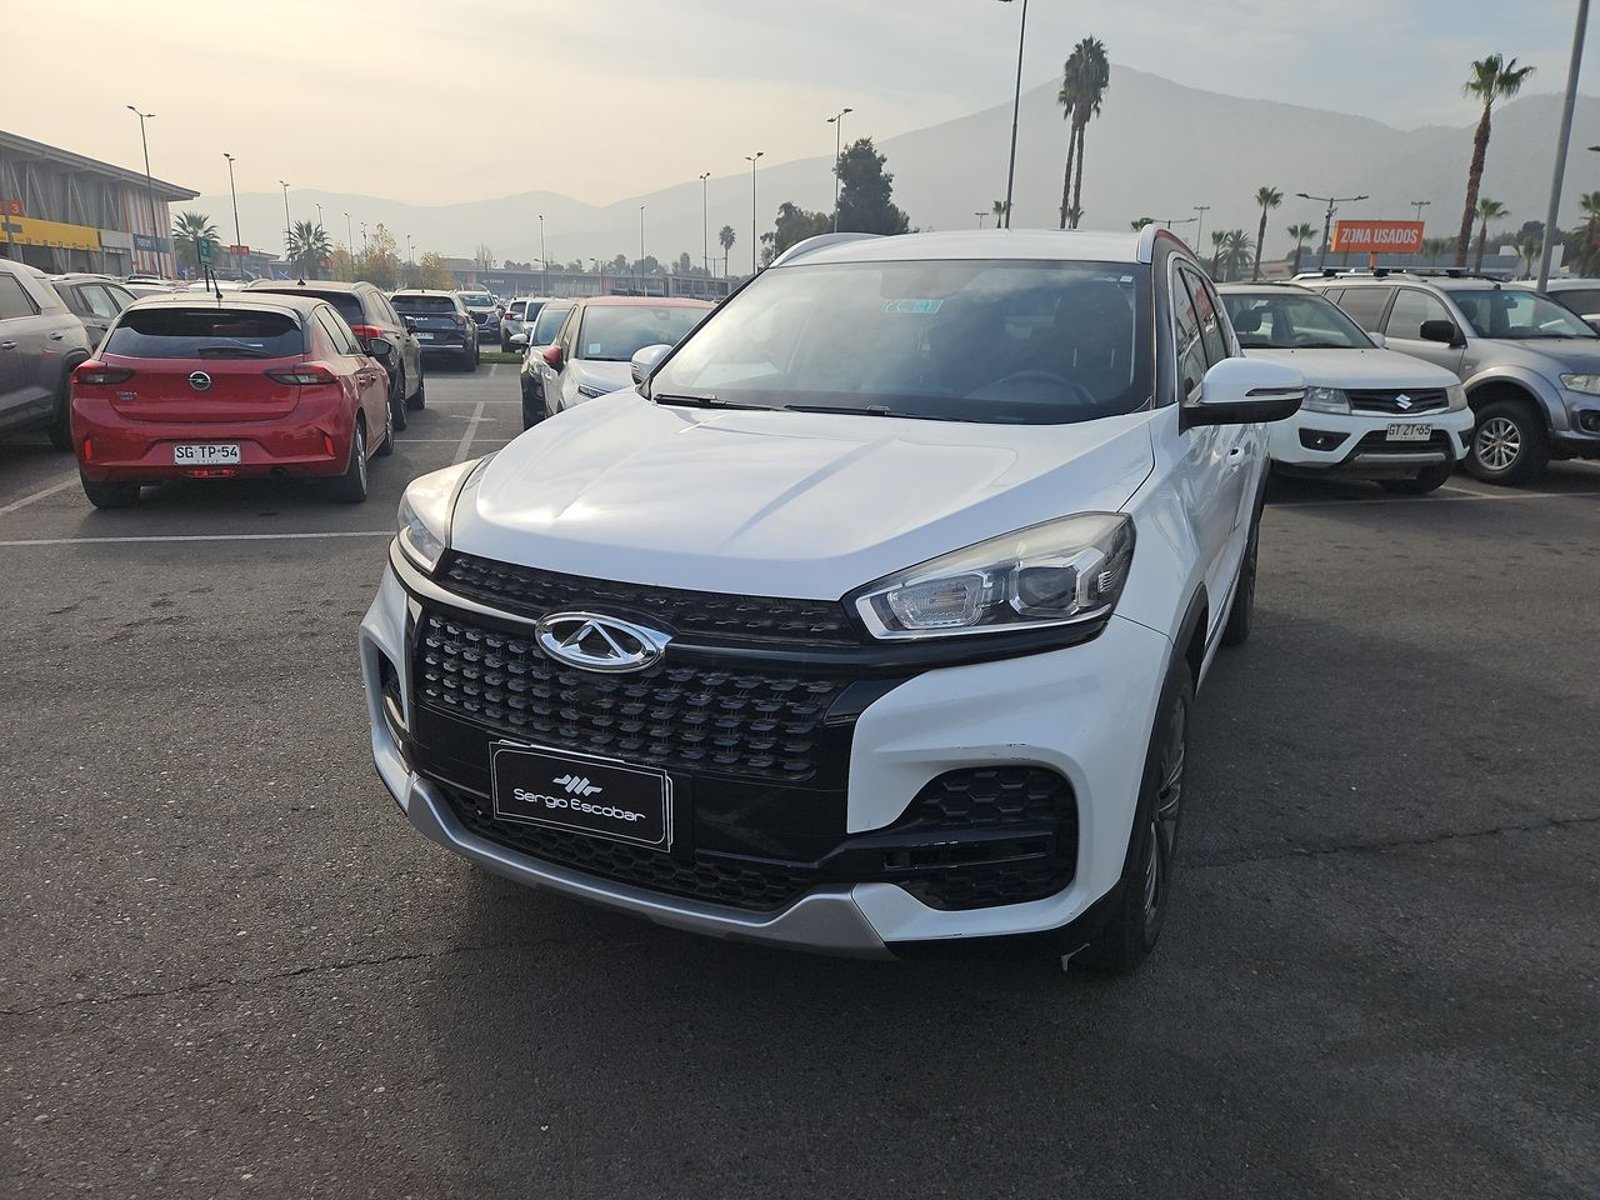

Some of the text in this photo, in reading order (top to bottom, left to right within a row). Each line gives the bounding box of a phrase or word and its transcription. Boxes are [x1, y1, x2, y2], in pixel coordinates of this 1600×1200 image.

[1341, 228, 1418, 244] ZONA USADOS
[570, 798, 646, 822] Escobar
